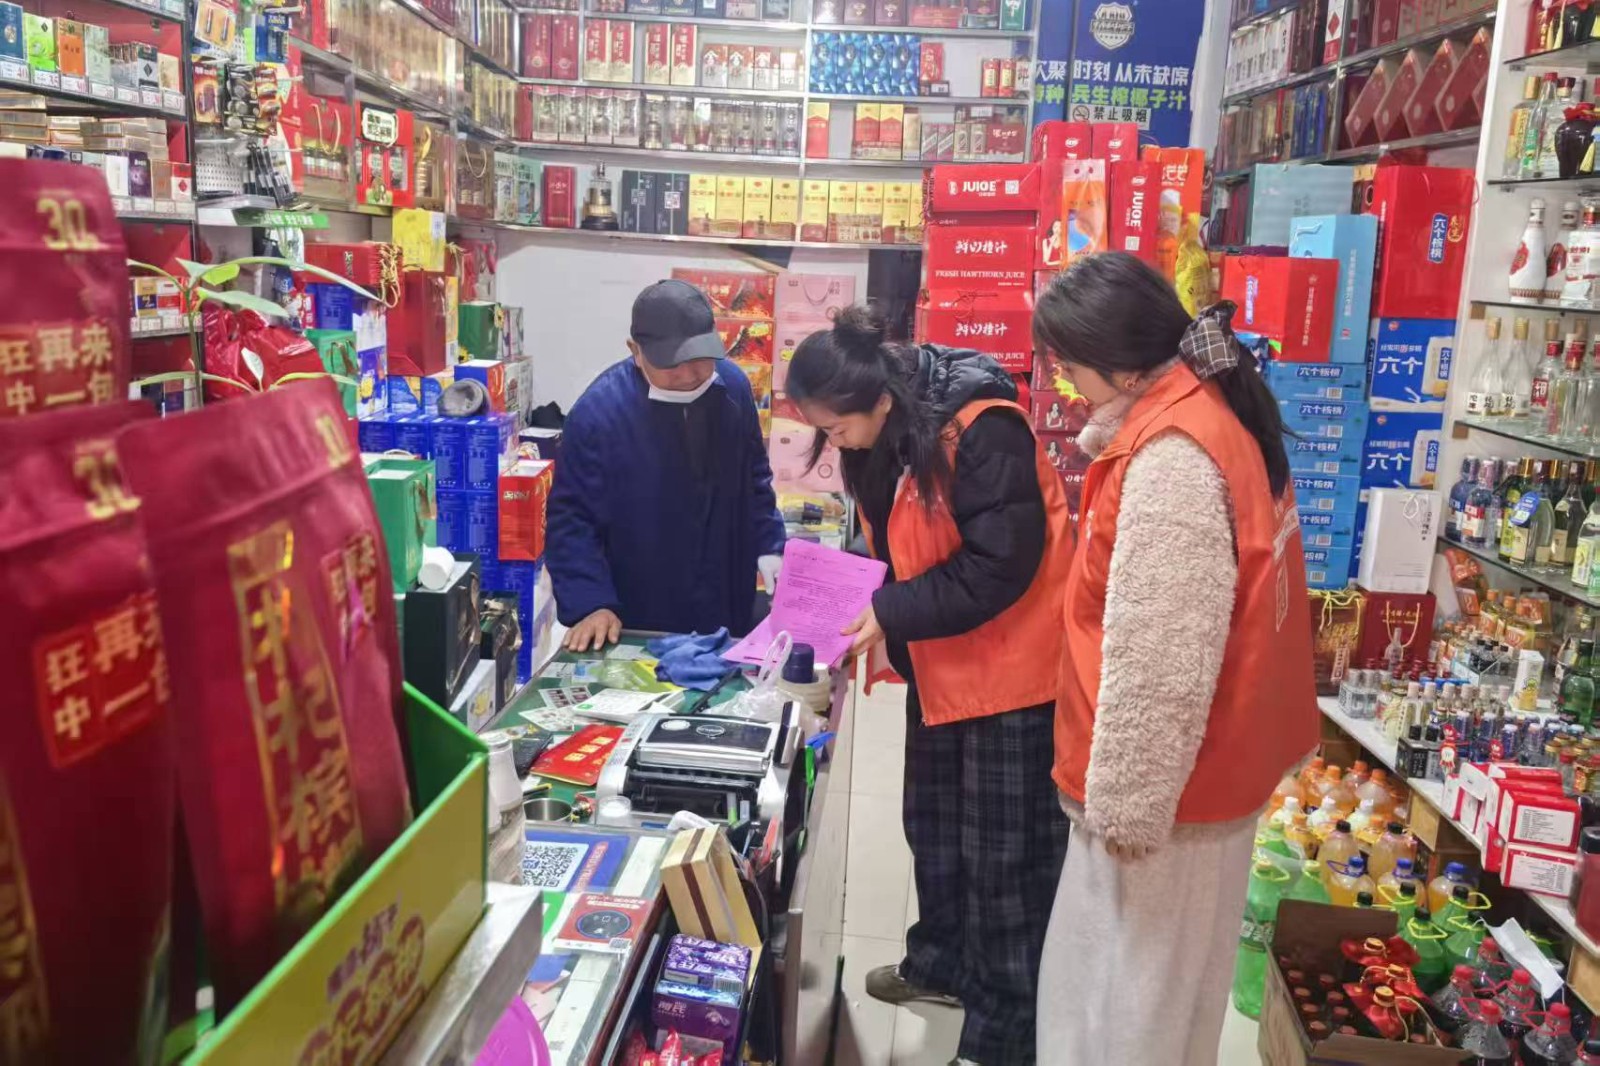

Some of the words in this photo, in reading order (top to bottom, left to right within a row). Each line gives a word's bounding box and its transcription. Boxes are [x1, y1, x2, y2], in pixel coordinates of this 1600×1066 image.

[1115, 64, 1190, 87] 从未缺席
[1093, 106, 1147, 123] 禁止吸烟
[1430, 218, 1447, 259] 六个核桃
[935, 270, 959, 278] FRESH
[960, 270, 1004, 279] HAWTHORN
[1005, 271, 1025, 279] JUICE
[1004, 352, 1025, 361] JUICE
[1377, 356, 1424, 375] 六个
[1299, 367, 1341, 377] 六个核桃
[1301, 404, 1343, 415] 六个核桃
[1296, 441, 1338, 452] 六个核桃
[1366, 452, 1411, 471] 六个
[1299, 515, 1331, 525] 个核桃
[1304, 551, 1325, 561] 核桃
